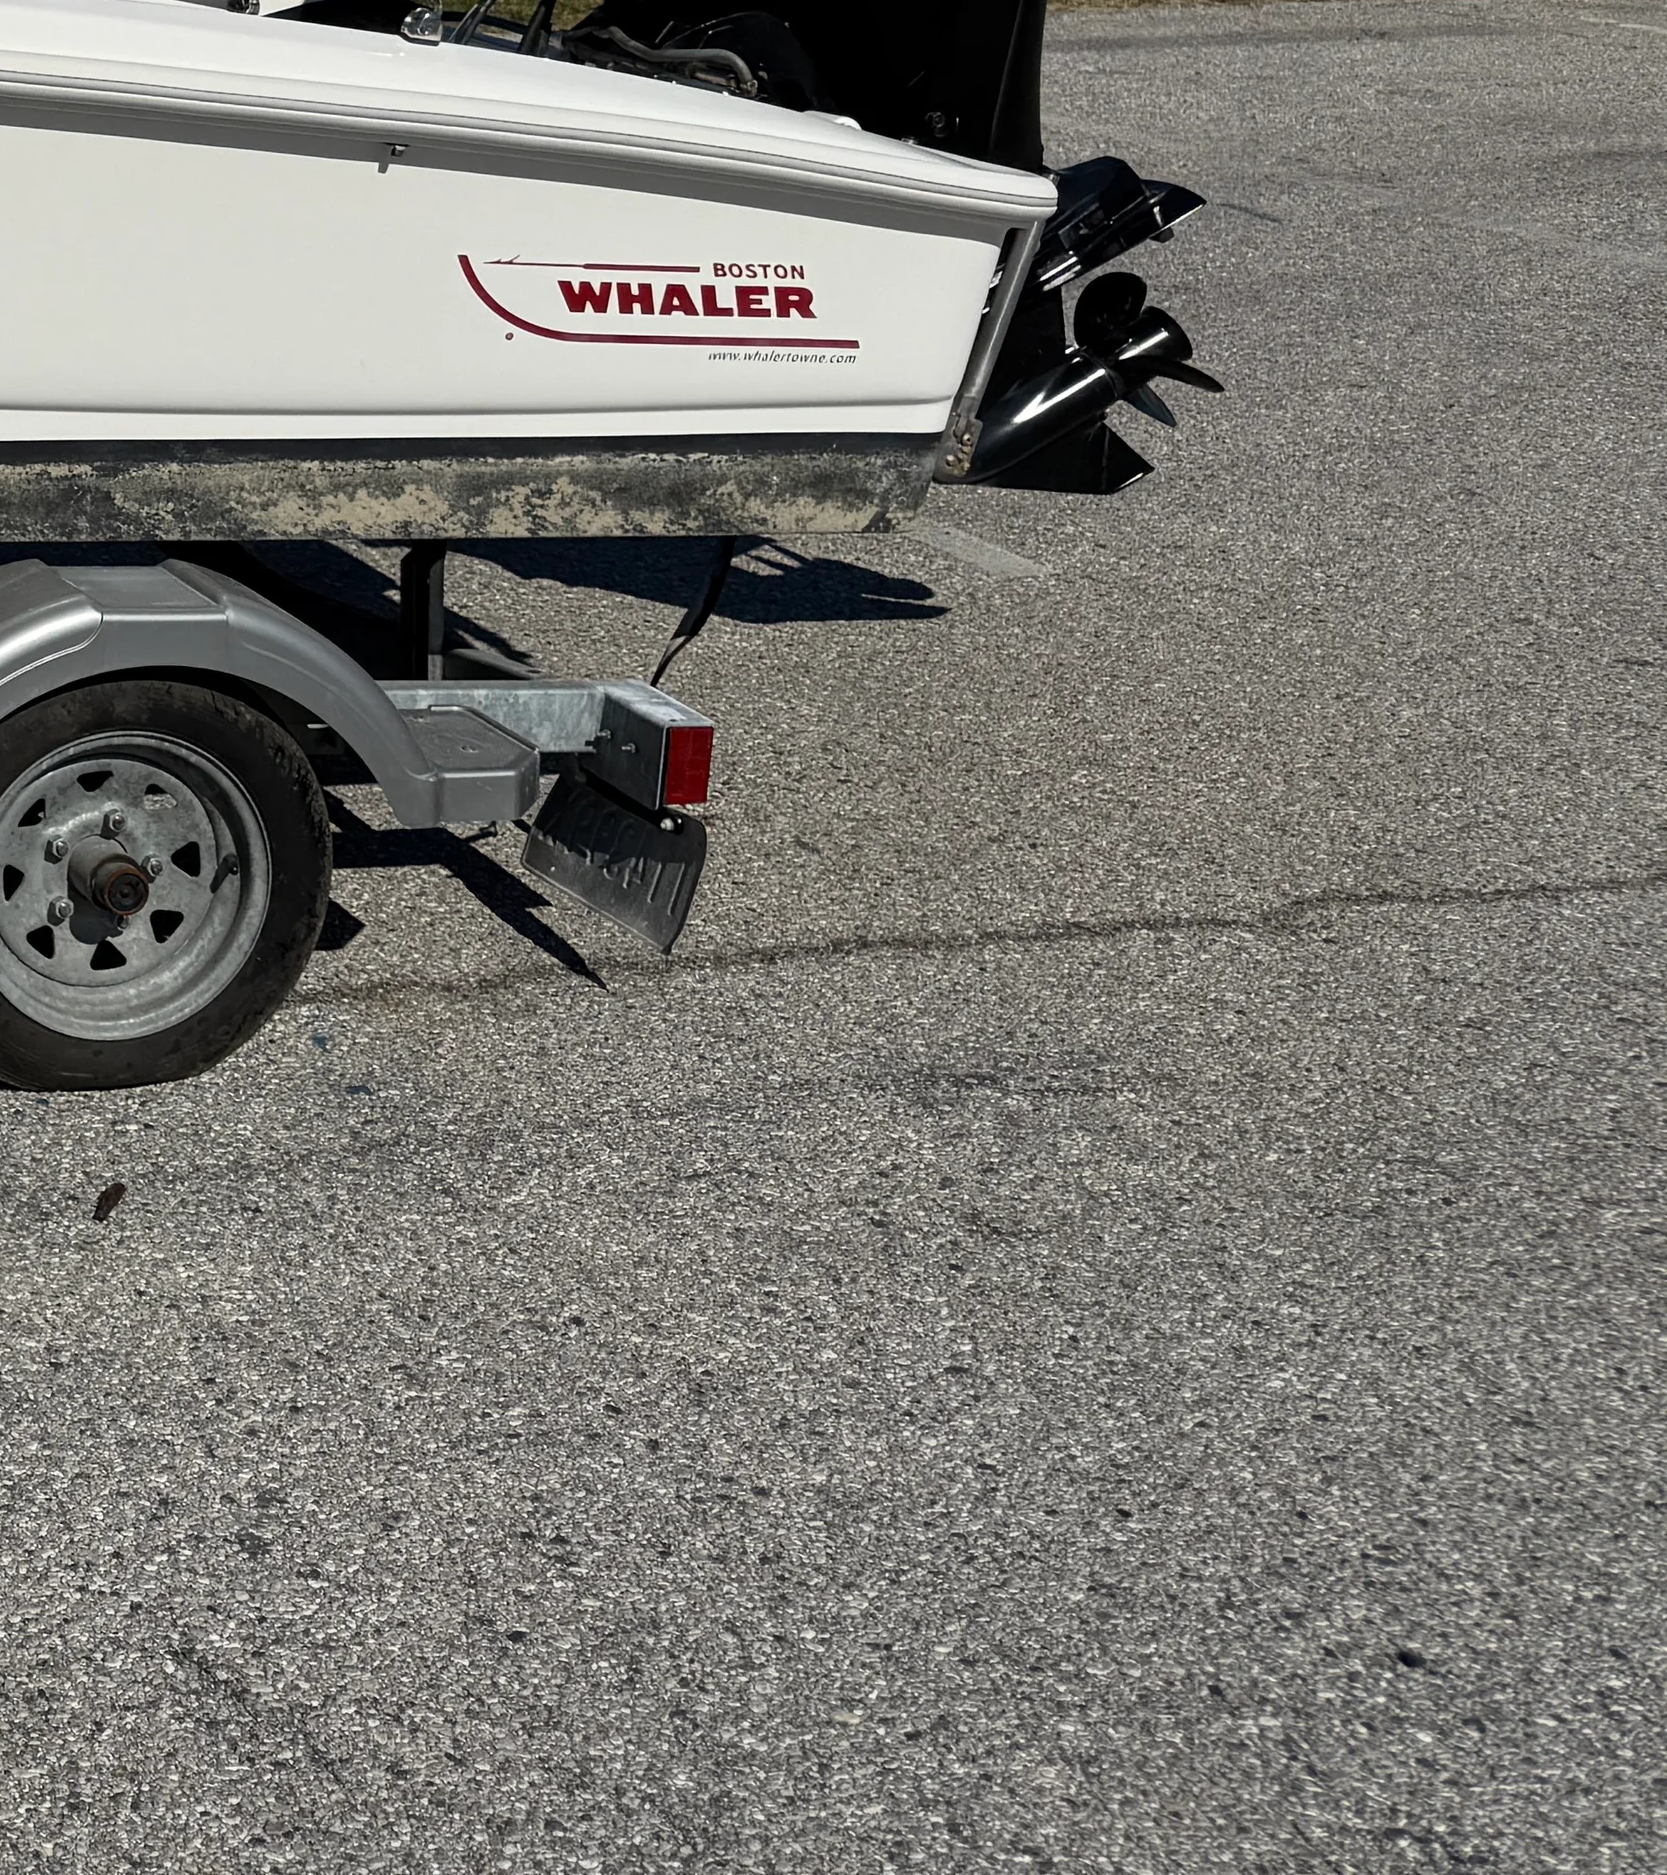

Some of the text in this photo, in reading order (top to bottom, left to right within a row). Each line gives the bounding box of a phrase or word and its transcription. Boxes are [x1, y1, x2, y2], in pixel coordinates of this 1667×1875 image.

[713, 262, 805, 280] BOSTON
[558, 280, 817, 319] WHALER
[708, 350, 857, 364] www.whalertowne.com
